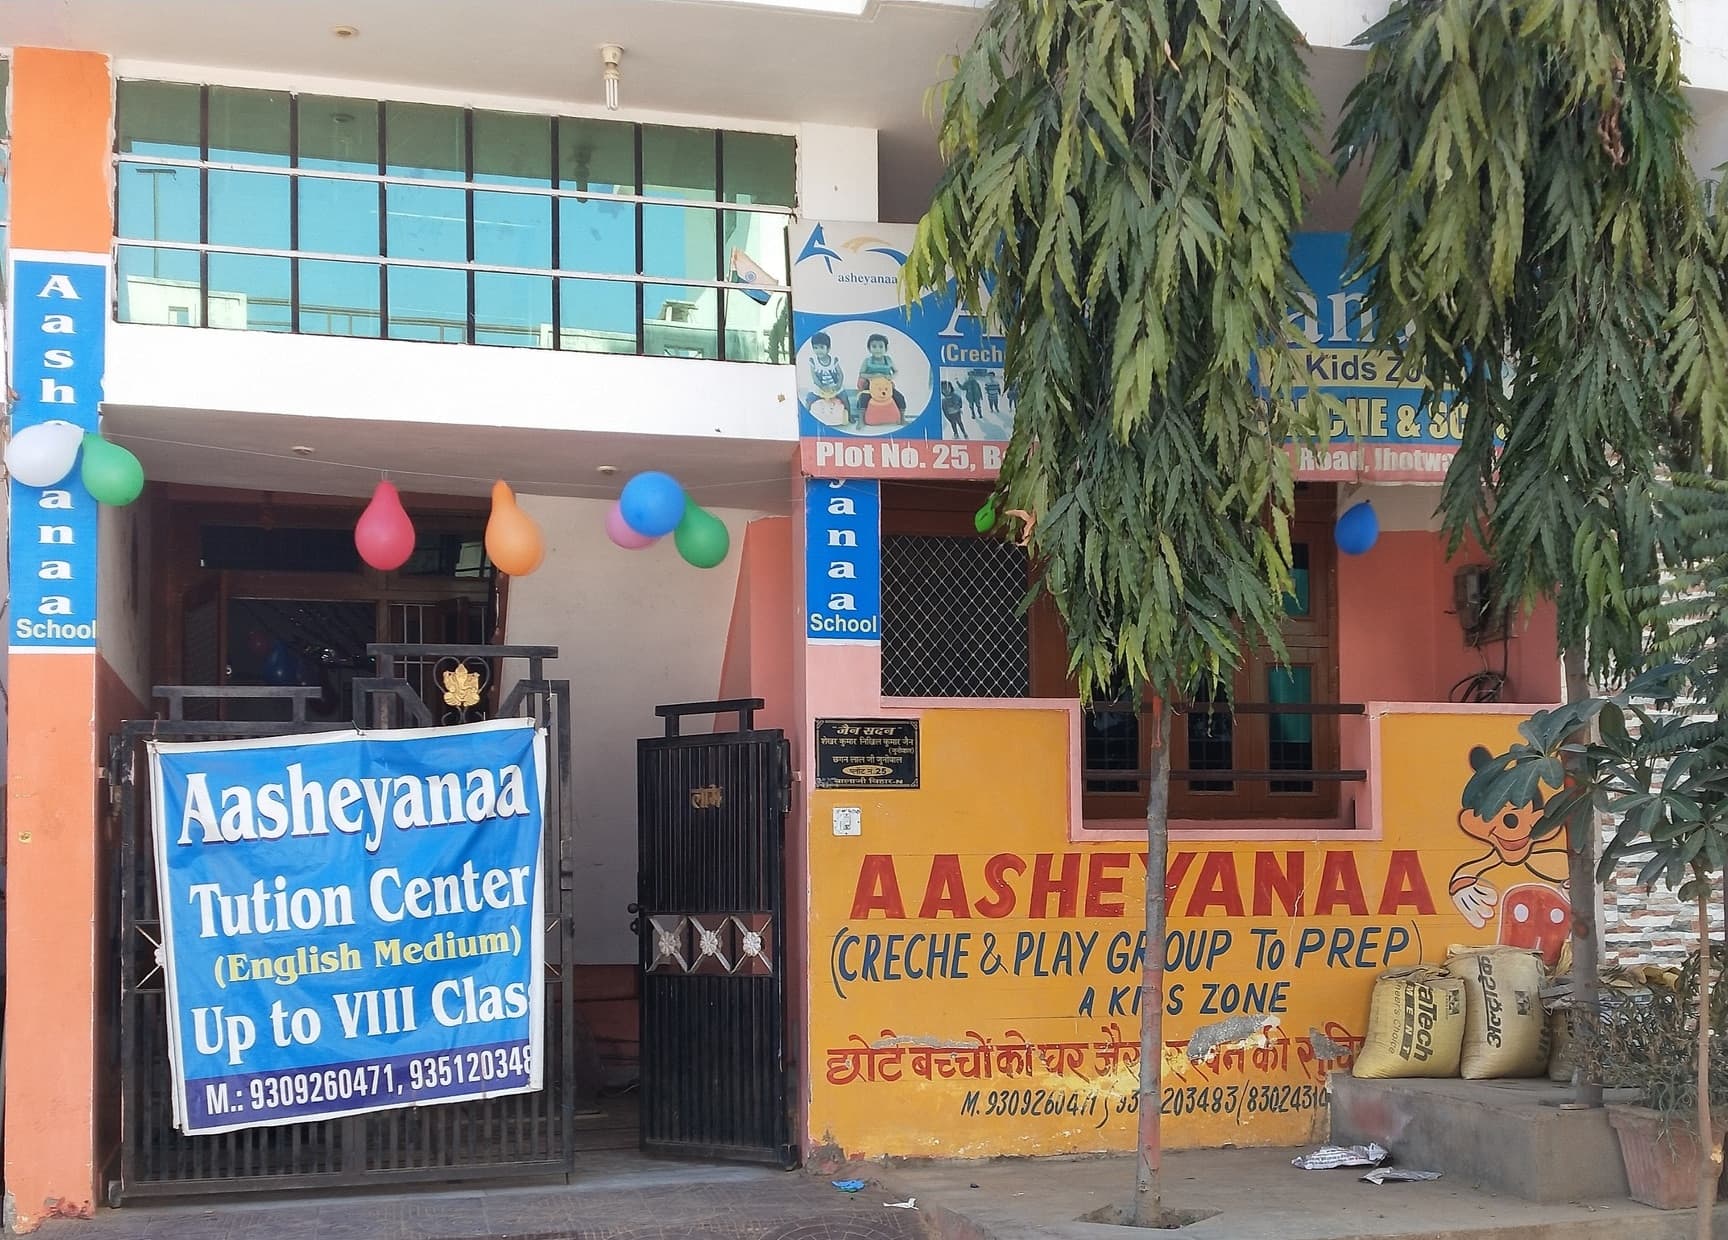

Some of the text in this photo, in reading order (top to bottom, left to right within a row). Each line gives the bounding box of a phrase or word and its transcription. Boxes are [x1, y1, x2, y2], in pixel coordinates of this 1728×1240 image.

[941, 343, 1006, 364] (Crech
[1306, 354, 1377, 382] Kids
[36, 274, 81, 616] Aashanaa
[816, 441, 875, 468] Plot
[882, 443, 925, 469] No.
[933, 444, 976, 472] 25,
[16, 617, 96, 641] School
[810, 613, 877, 633] School
[836, 724, 896, 736] जैन सदन
[875, 767, 887, 775] 25
[177, 763, 530, 853] Aasheyanaa
[188, 860, 530, 939] Tution Center
[850, 850, 1437, 919] AASHEYANAA
[214, 926, 521, 989] (English Medium)
[831, 927, 971, 999] (CRECHE
[980, 932, 1008, 975] &
[1013, 930, 1099, 977] PLAY
[1250, 928, 1285, 971] To
[1294, 919, 1423, 969] PREP)
[191, 978, 532, 1067] Up to VIII Clas
[1078, 981, 1290, 1019] A KIS ZONE
[1413, 984, 1437, 1062] aTech
[826, 1029, 905, 1086] छोटे
[996, 1030, 1036, 1079] को
[206, 1082, 243, 1115] M.:
[250, 1066, 403, 1111] 9309260471,
[961, 1090, 980, 1117] M.
